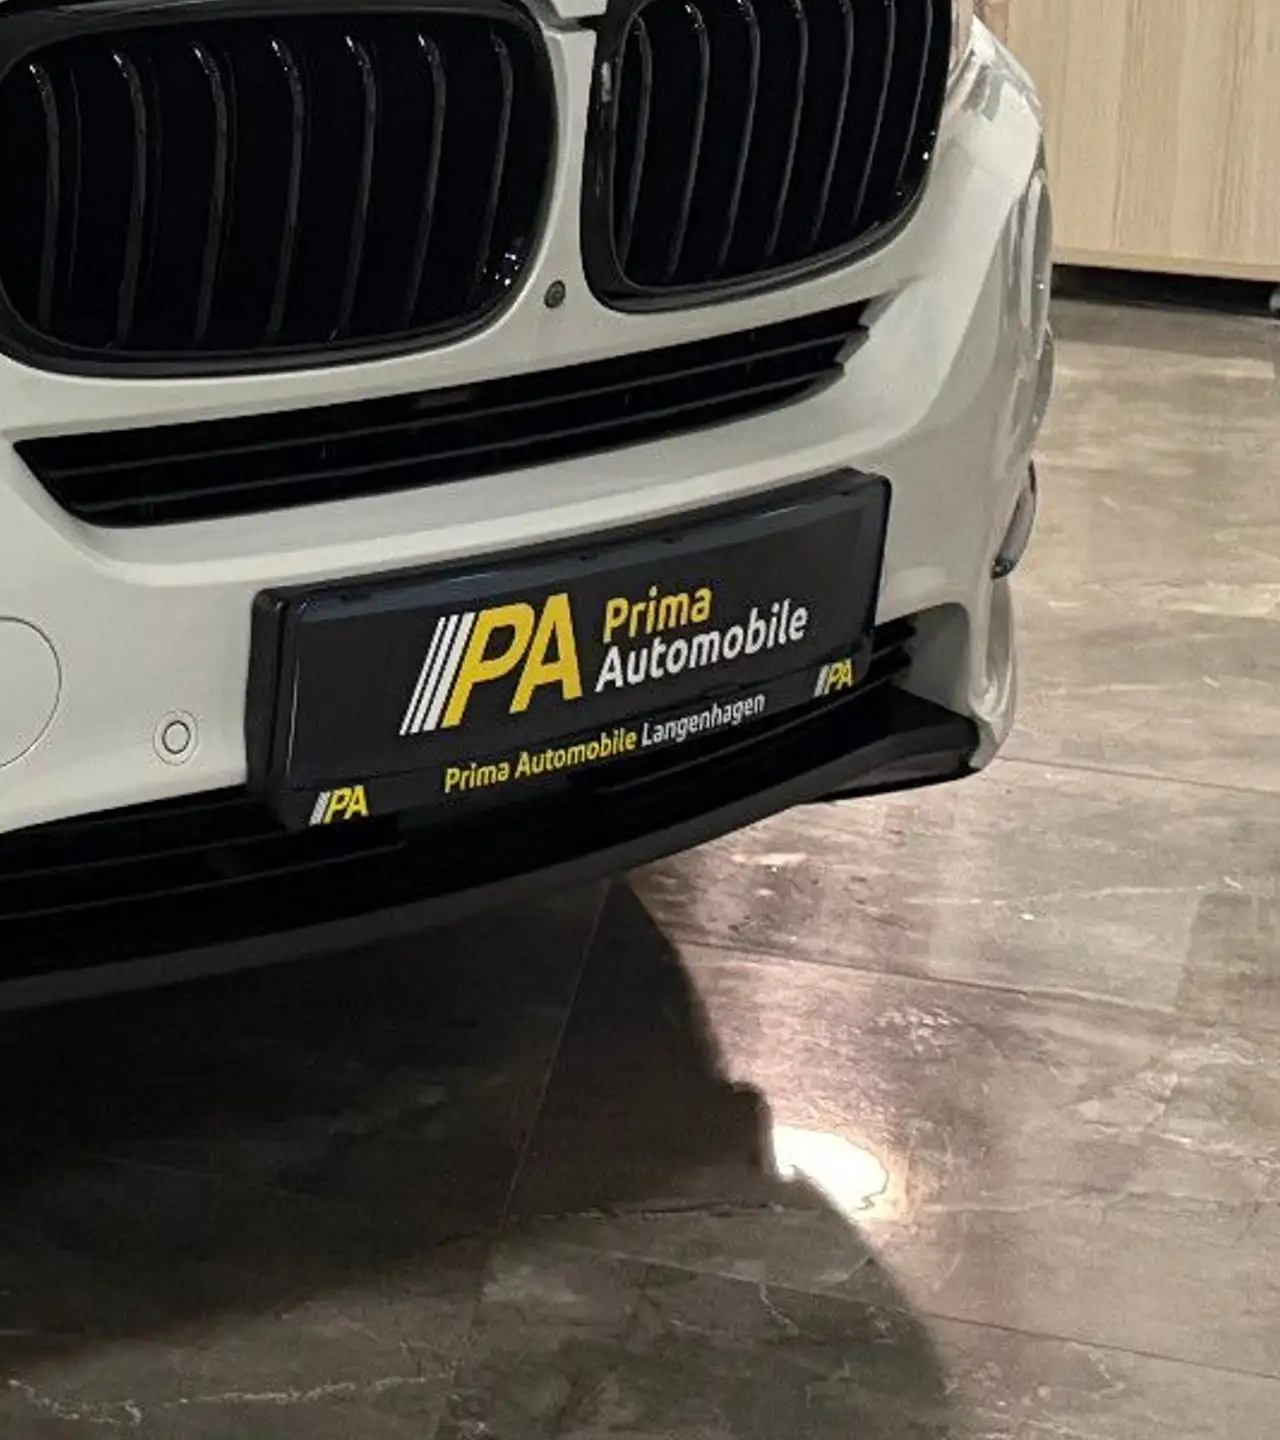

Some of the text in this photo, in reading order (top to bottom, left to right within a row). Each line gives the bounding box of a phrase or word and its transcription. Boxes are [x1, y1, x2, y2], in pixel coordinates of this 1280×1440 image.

[443, 593, 582, 729] PA
[596, 599, 808, 693] Automobile
[604, 587, 711, 644] Prima
[444, 694, 765, 793] Prima Automobile Langenhagen
[326, 785, 369, 824] PA
